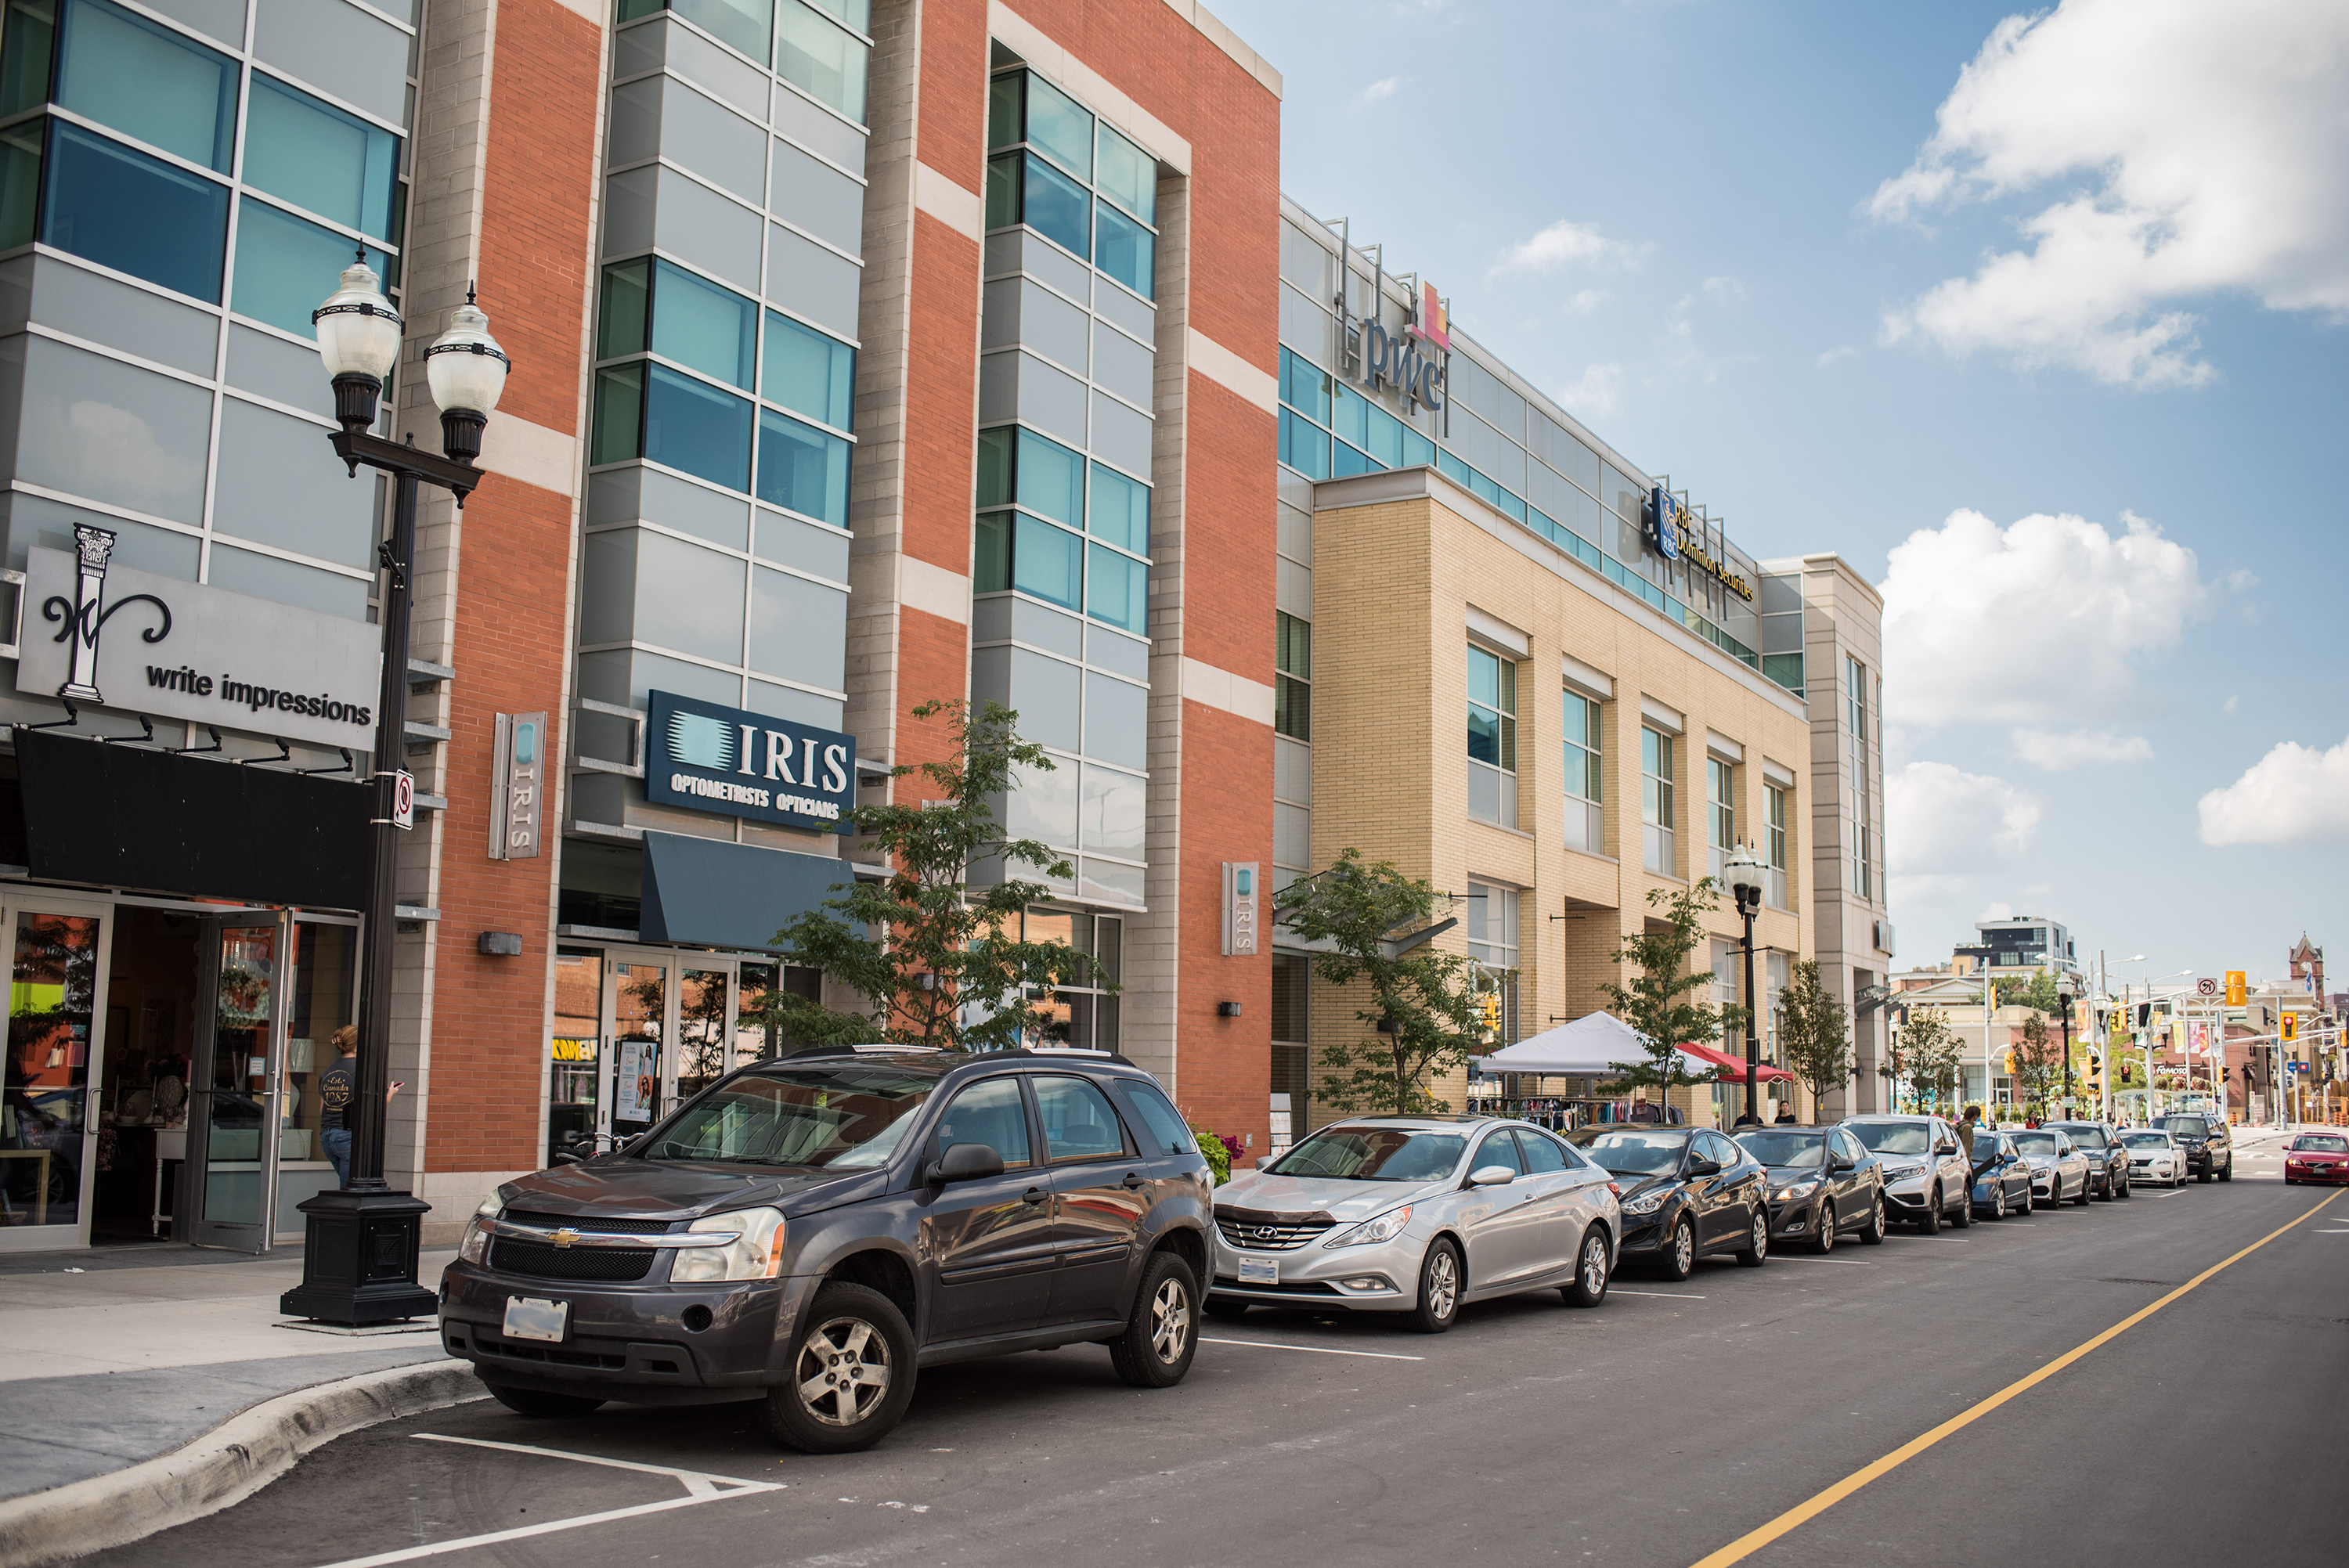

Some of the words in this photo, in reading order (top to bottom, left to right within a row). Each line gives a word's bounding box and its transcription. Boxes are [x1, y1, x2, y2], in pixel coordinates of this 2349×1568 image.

[1675, 504, 1692, 534] RBC
[1662, 535, 1676, 556] RBC
[1676, 529, 1716, 575] Dominion
[1718, 561, 1753, 602] Securities
[146, 665, 213, 695] write
[222, 674, 371, 725] impressions
[737, 724, 847, 793] IRIS
[511, 768, 533, 848] IRIS
[671, 773, 769, 807] OPTOMETRISTS
[776, 793, 839, 820] OPTICIANS
[1236, 898, 1251, 949] IRIS
[325, 1092, 348, 1101] 1987
